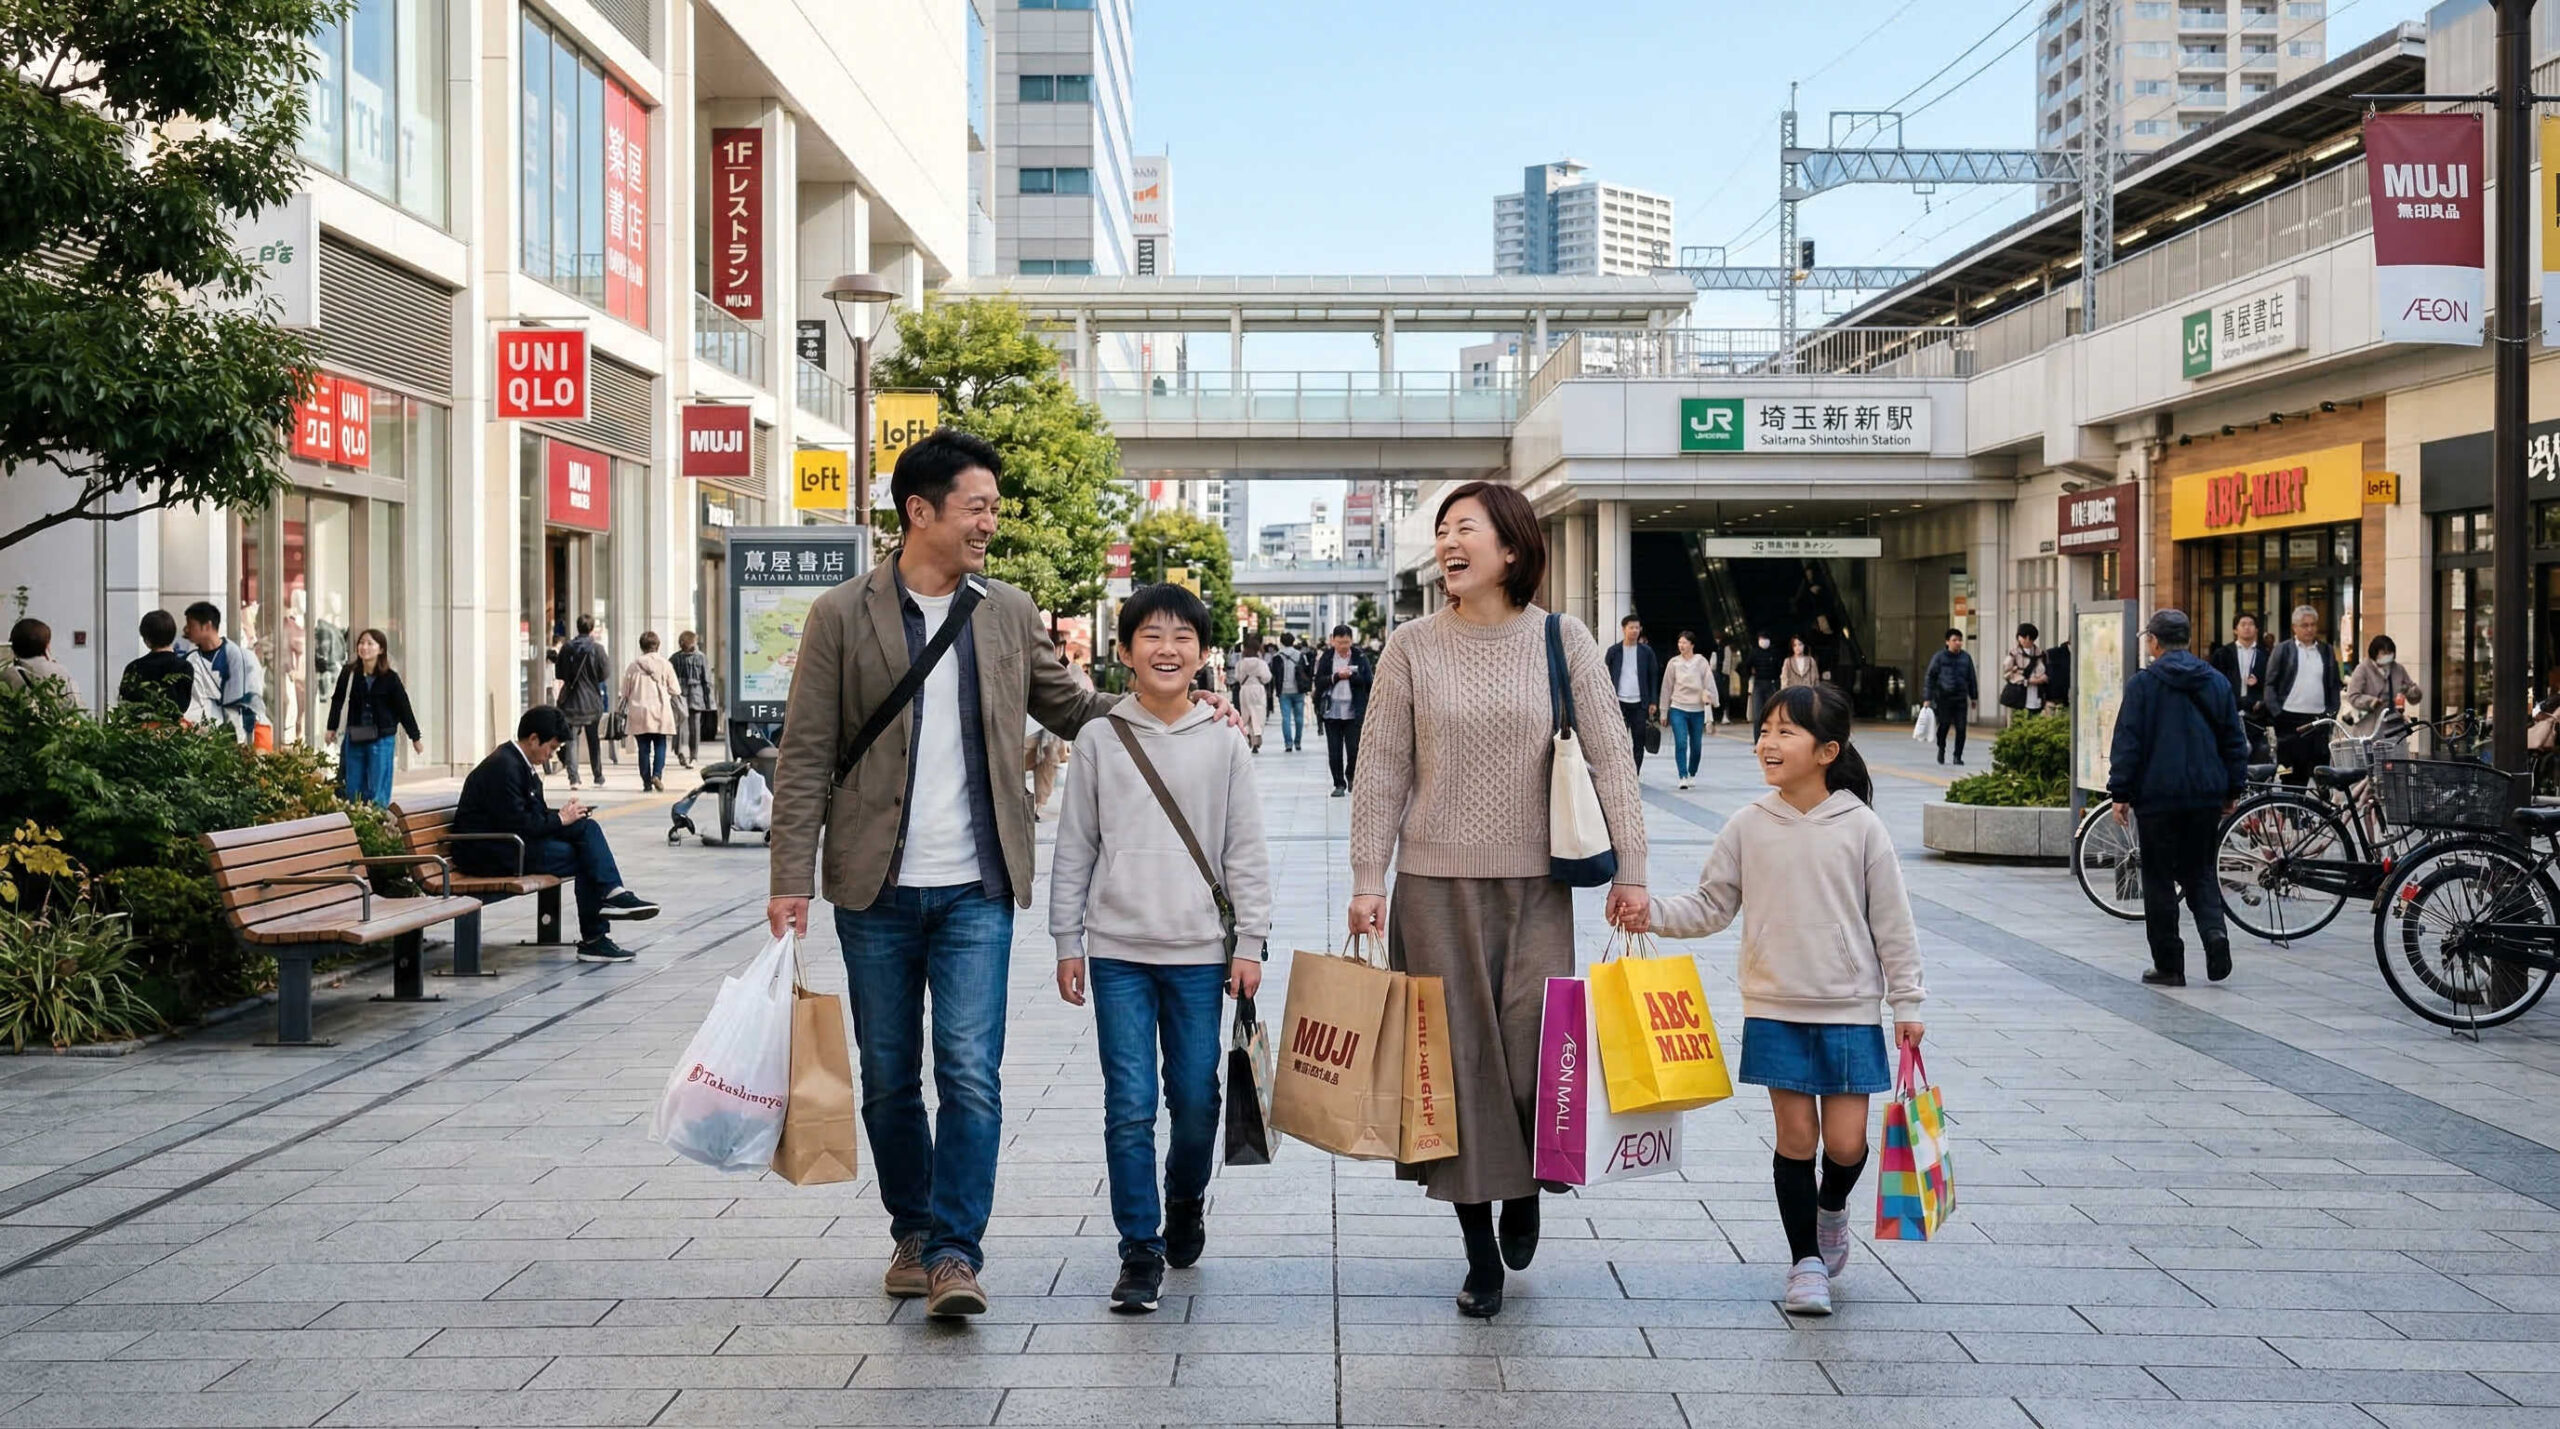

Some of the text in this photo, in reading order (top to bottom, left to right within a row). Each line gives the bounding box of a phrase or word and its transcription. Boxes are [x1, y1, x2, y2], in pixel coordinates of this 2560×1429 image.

[723, 142, 753, 164] 1F
[2383, 164, 2468, 198] MUJI
[2397, 203, 2460, 219] 無印良品
[727, 173, 749, 288] レストラン
[725, 294, 752, 308] MUJI
[2187, 322, 2208, 355] JR
[508, 342, 568, 371] UNI
[341, 391, 364, 424] UNI
[508, 377, 574, 412] QLO
[306, 418, 331, 448] クロ
[1691, 408, 1734, 432] JR
[1760, 404, 1912, 431] 埼玉新新駅
[341, 424, 366, 459] QLO
[690, 430, 742, 452] MUJI
[1810, 433, 1869, 446] Shintoshin
[1872, 433, 1911, 446] Station
[2205, 466, 2306, 528] ABC-MART
[750, 705, 767, 718] 1F
[1643, 990, 1699, 1031] ABC
[1292, 1016, 1360, 1070] MUJI
[1655, 1032, 1713, 1063] MART
[1556, 1086, 1572, 1135] MALL
